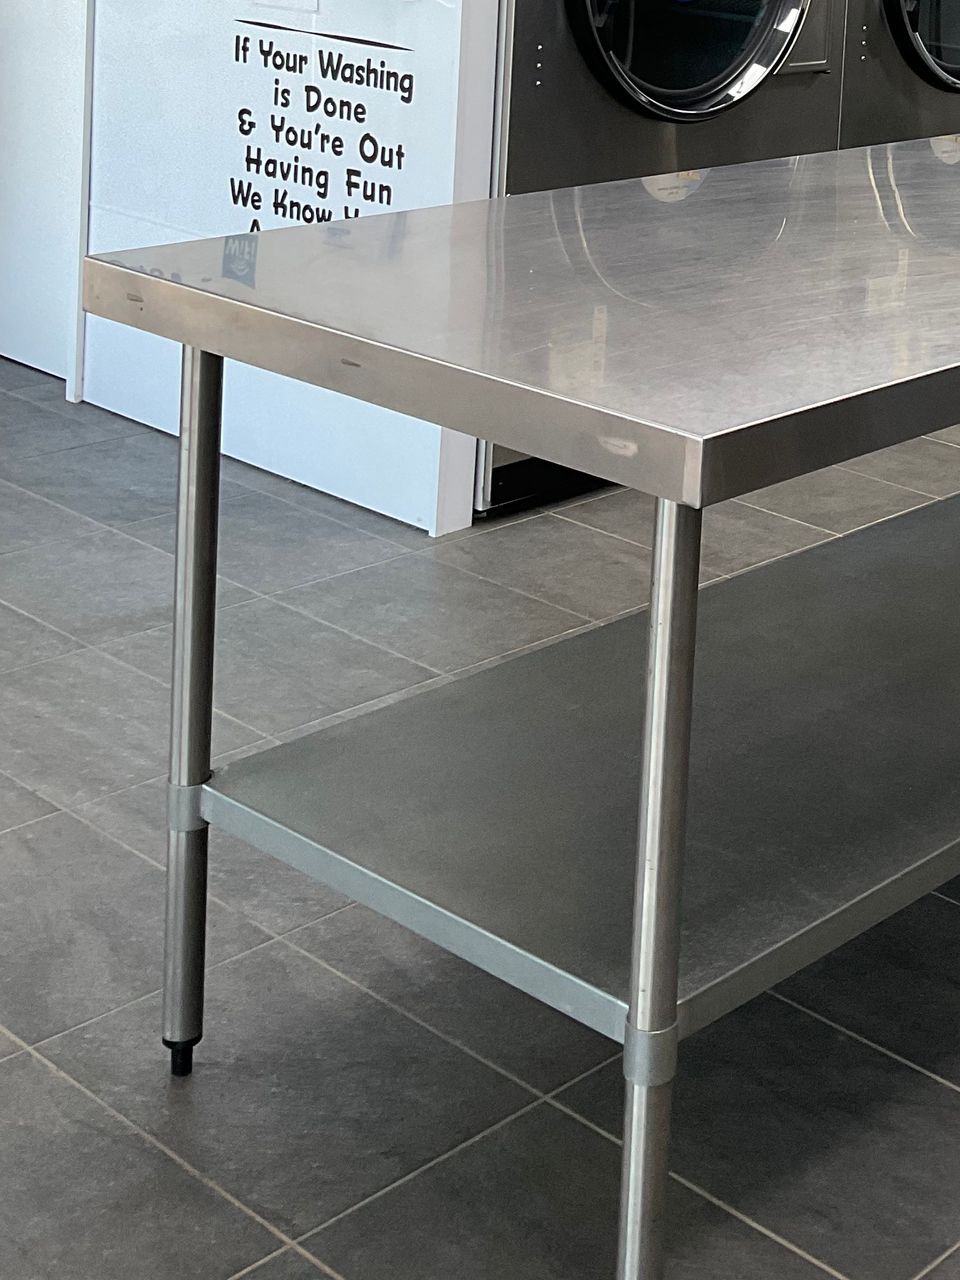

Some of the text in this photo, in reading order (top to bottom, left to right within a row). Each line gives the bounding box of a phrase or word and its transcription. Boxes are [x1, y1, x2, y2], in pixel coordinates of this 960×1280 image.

[234, 35, 414, 103] If Your Washing
[273, 78, 367, 123] is Done
[238, 108, 405, 170] & You're Out
[230, 177, 262, 210] We
[272, 188, 333, 223] Know
[245, 145, 392, 206] Having Fun
